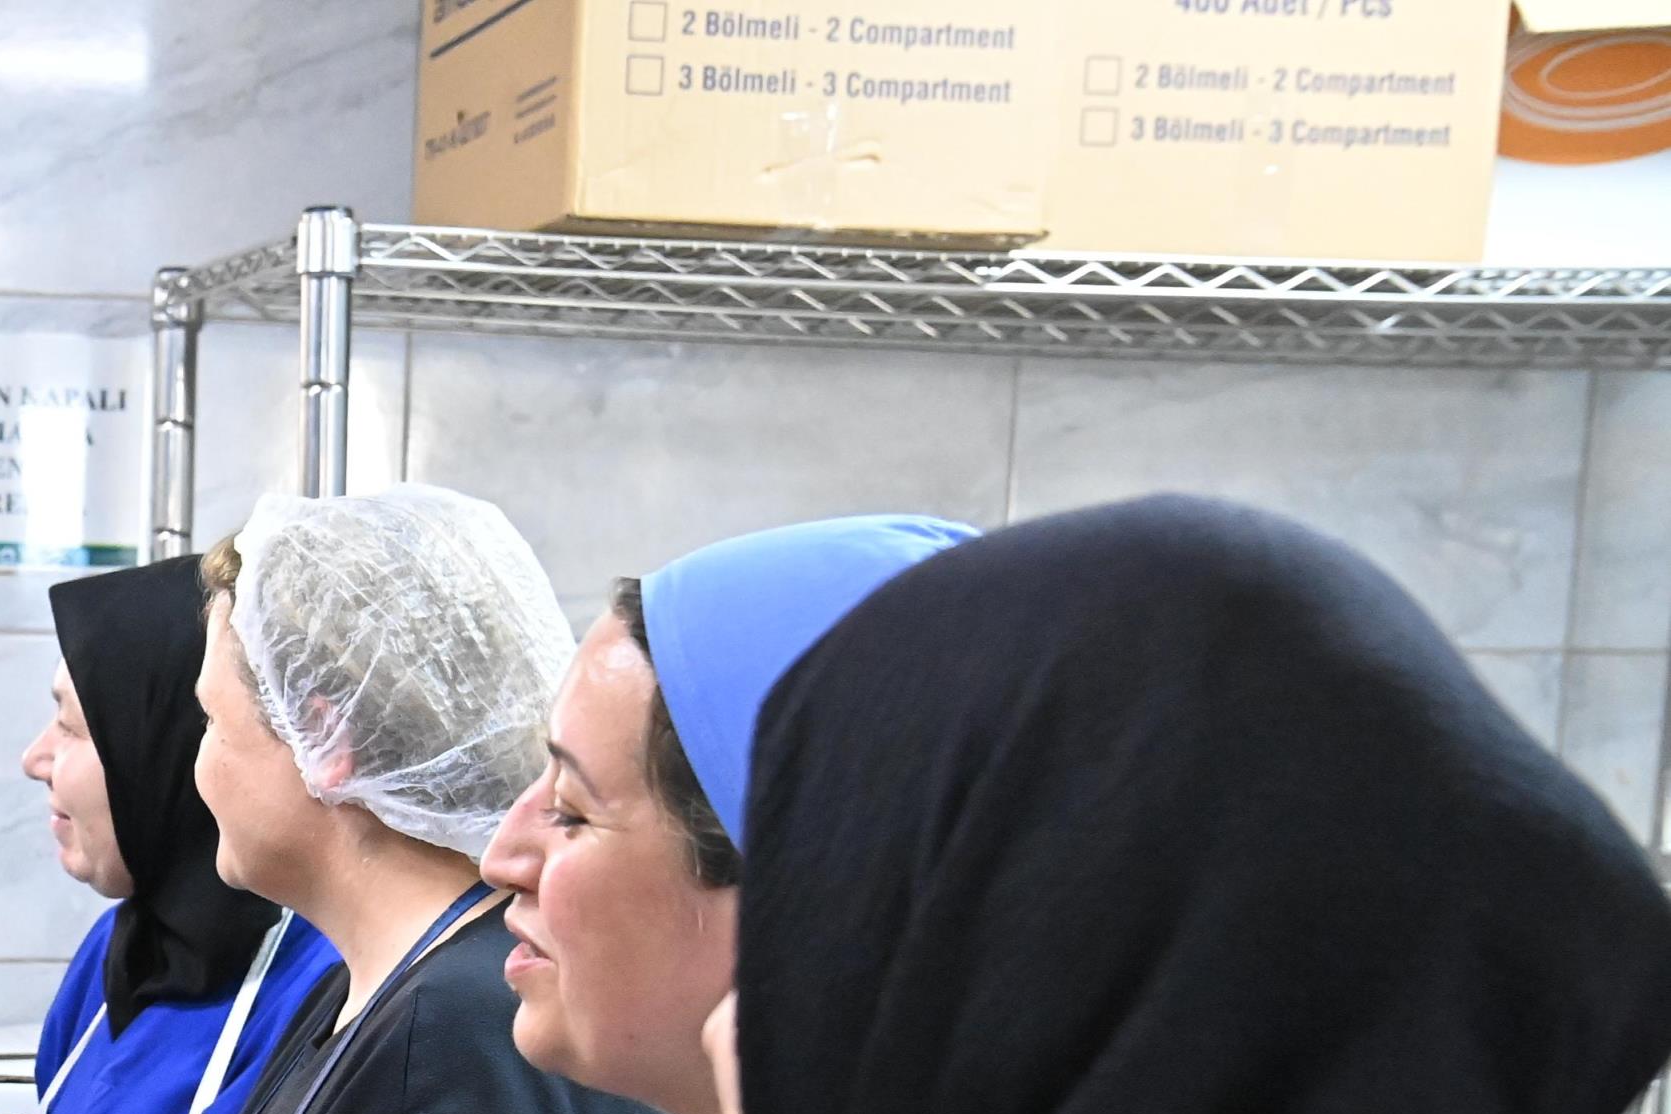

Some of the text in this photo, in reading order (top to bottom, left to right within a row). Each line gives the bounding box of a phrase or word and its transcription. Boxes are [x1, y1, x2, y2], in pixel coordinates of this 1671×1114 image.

[682, 10, 697, 36] 2
[705, 11, 801, 41] Bölmeli
[826, 16, 841, 43] 2
[849, 16, 1016, 51] Compartment
[678, 64, 693, 90] 3
[702, 65, 797, 95] Bölmeli
[822, 71, 837, 97] 3
[845, 71, 1012, 106] Compartment
[1134, 63, 1149, 89] 2
[1157, 63, 1250, 91] Bölmeli
[1273, 67, 1289, 92] 2
[1295, 67, 1456, 99] Compartment
[1130, 115, 1145, 141] 3
[1153, 115, 1245, 142] Bölmeli
[1268, 119, 1284, 144] 3
[1290, 118, 1451, 150] Compartment
